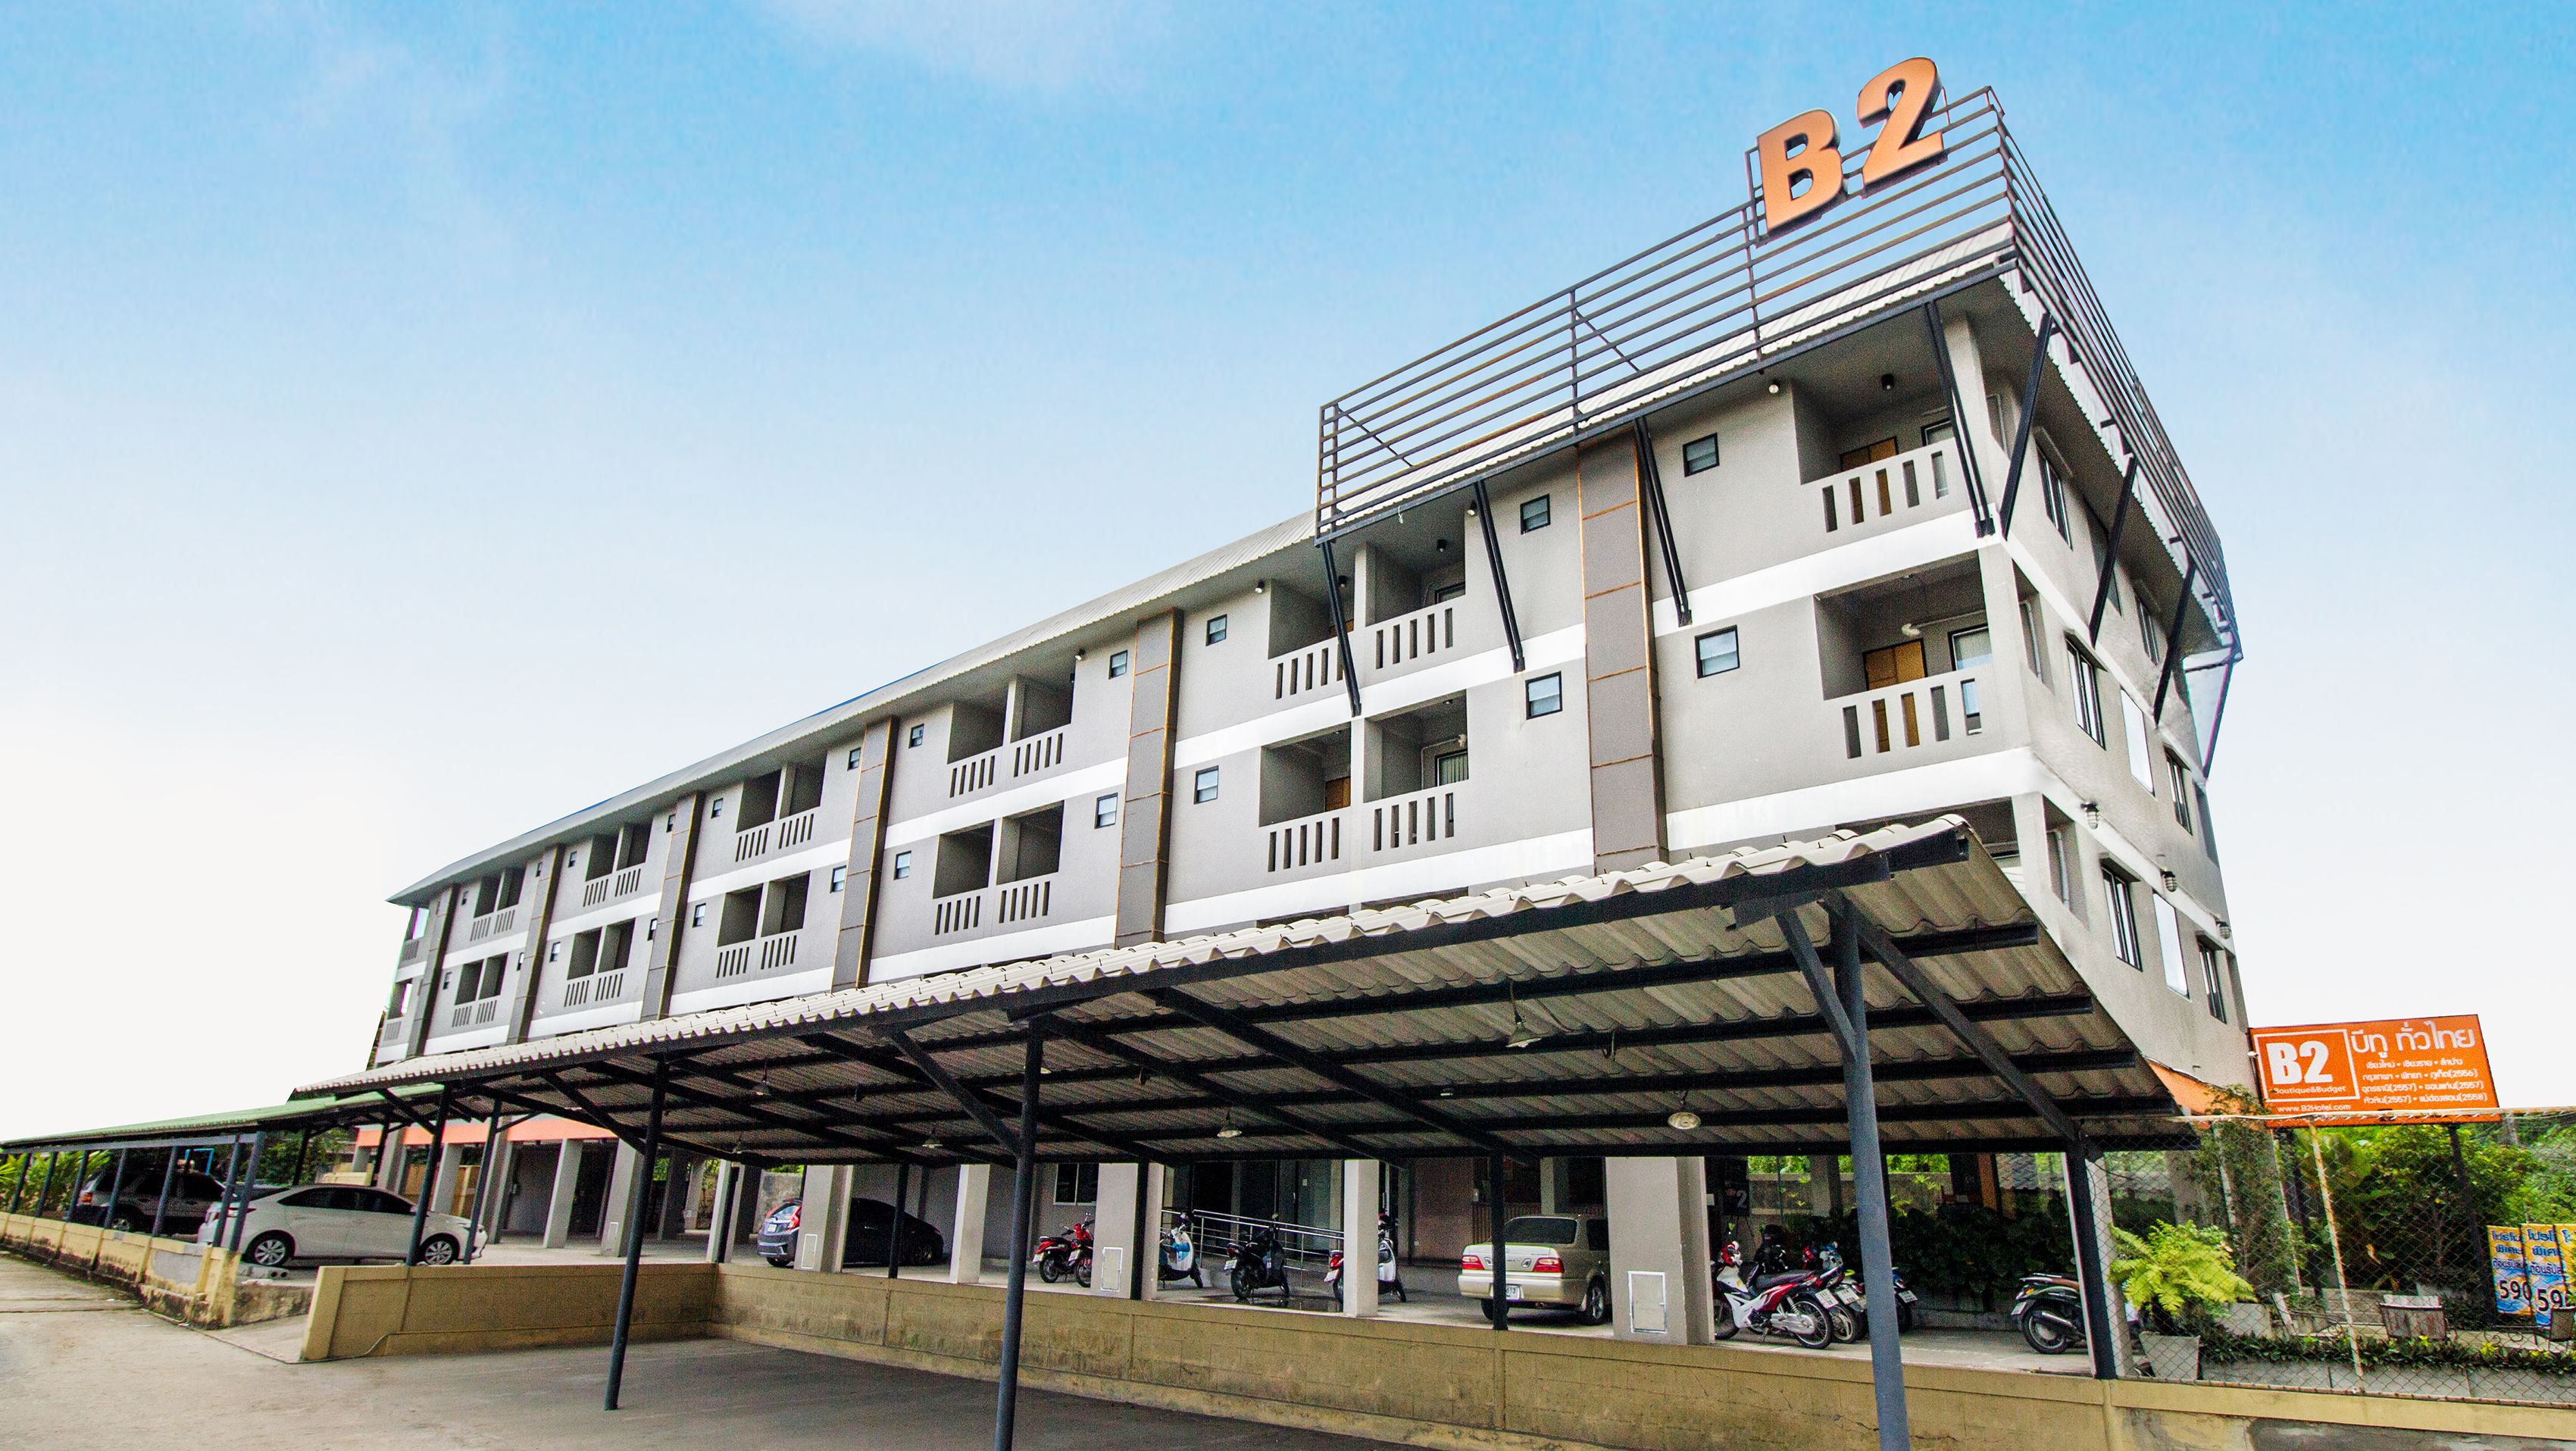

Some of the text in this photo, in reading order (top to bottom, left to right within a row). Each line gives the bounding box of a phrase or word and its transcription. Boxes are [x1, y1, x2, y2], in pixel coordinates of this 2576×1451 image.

[1756, 56, 1947, 235] B2
[2265, 1040, 2333, 1084] B2
[2351, 1021, 2476, 1059] บีทู ทั่วไทย
